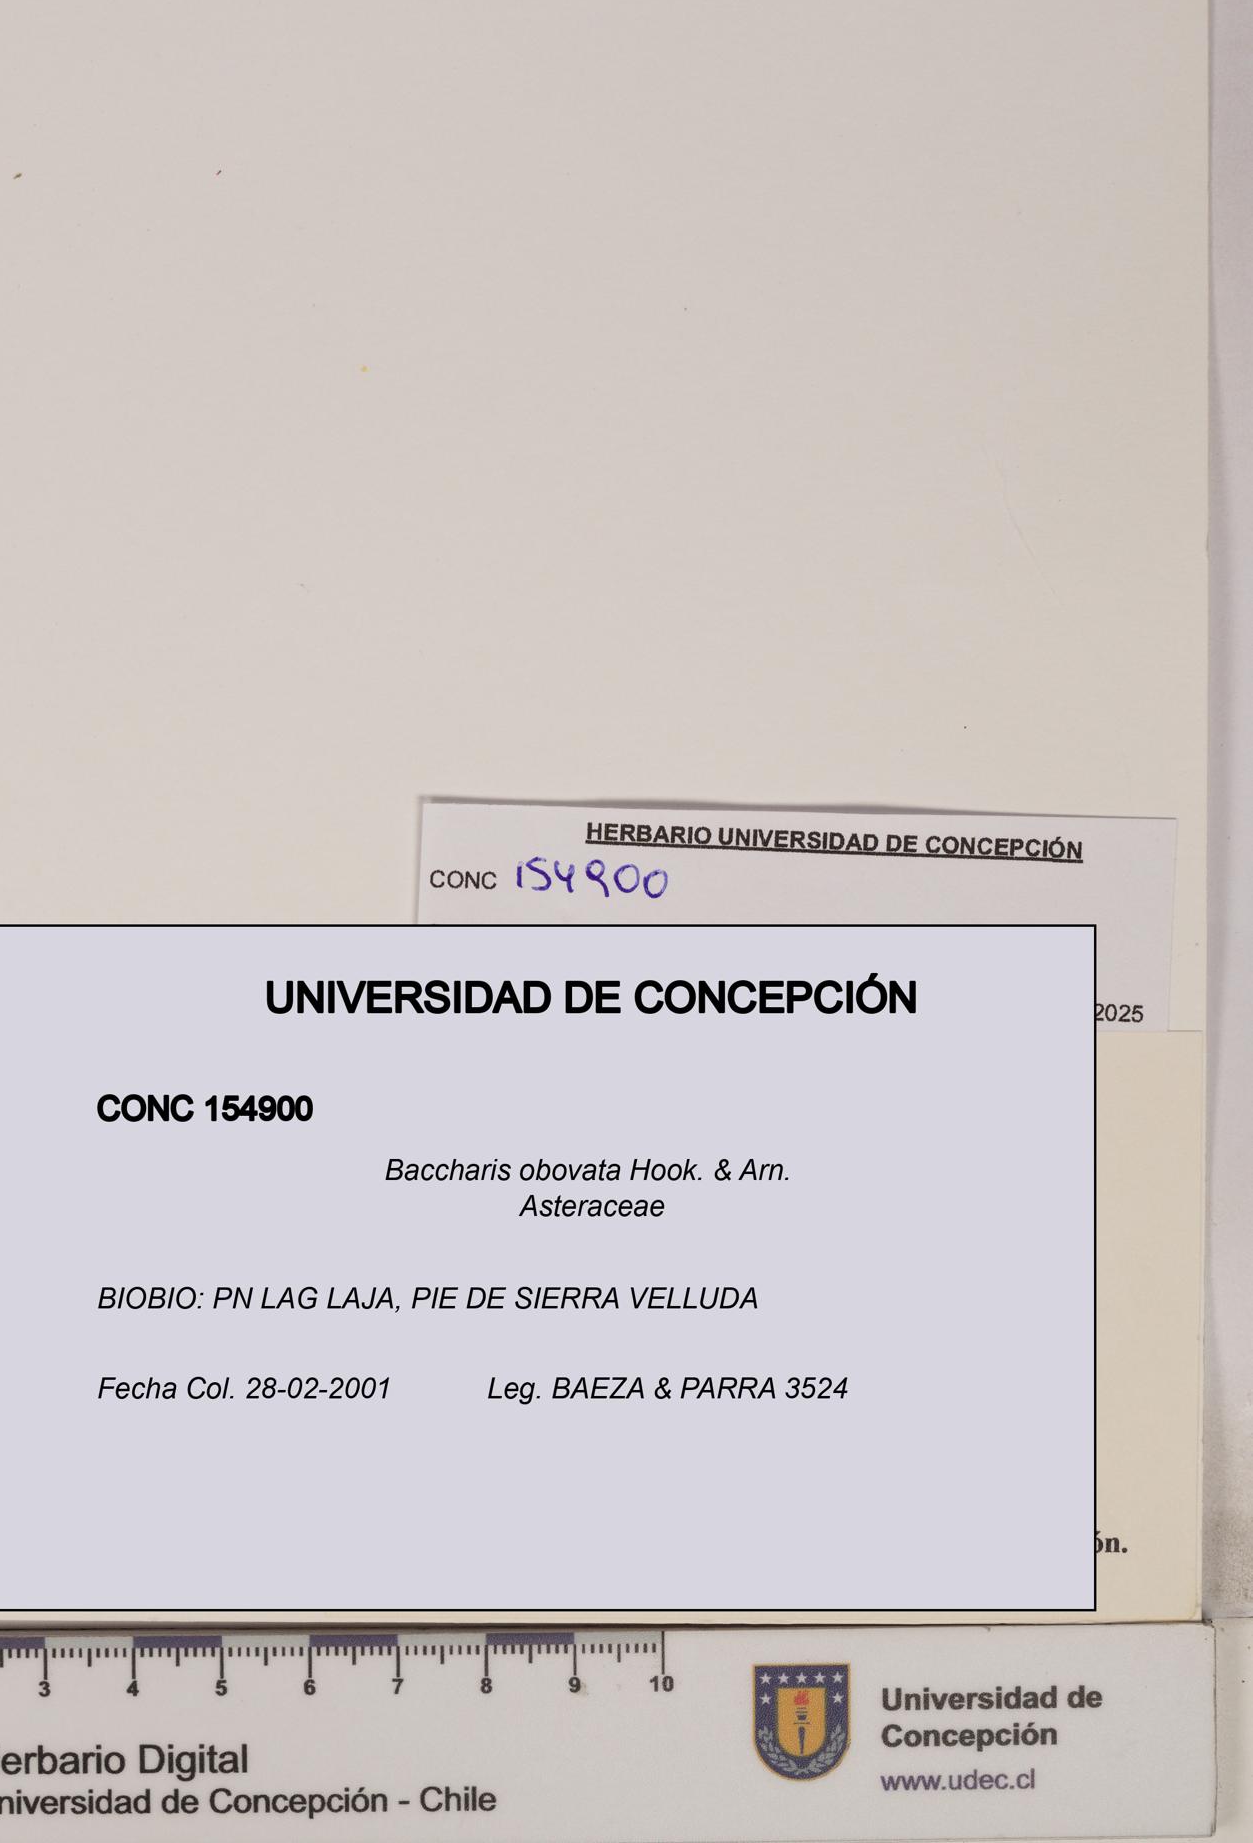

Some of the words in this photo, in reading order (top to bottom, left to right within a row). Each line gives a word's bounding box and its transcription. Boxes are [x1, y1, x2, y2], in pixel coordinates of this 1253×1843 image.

[585, 822, 712, 845] HERBARIO
[717, 827, 879, 853] UNIVERSIDAD
[885, 833, 918, 853] DE
[924, 835, 1083, 860] CONCEPCIÓN
[429, 869, 497, 890] CONC
[516, 856, 668, 899] 154900
[1096, 1003, 1144, 1024] 2025
[38, 1680, 51, 1698] 3
[126, 1680, 140, 1697] 4
[215, 1679, 228, 1697] 5
[303, 1678, 316, 1696] 6
[391, 1678, 404, 1695] 7
[480, 1677, 493, 1694] 8
[568, 1676, 582, 1694] 9
[649, 1675, 674, 1693] 10
[882, 1685, 1058, 1712] Universidad
[1066, 1684, 1103, 1709] de
[880, 1721, 1058, 1753] Concepción
[138, 1743, 248, 1782] Digital
[880, 1767, 1036, 1792] www.udec.cl
[161, 1788, 200, 1815] de
[209, 1786, 388, 1820] Concepción
[419, 1785, 497, 1813] Chile
